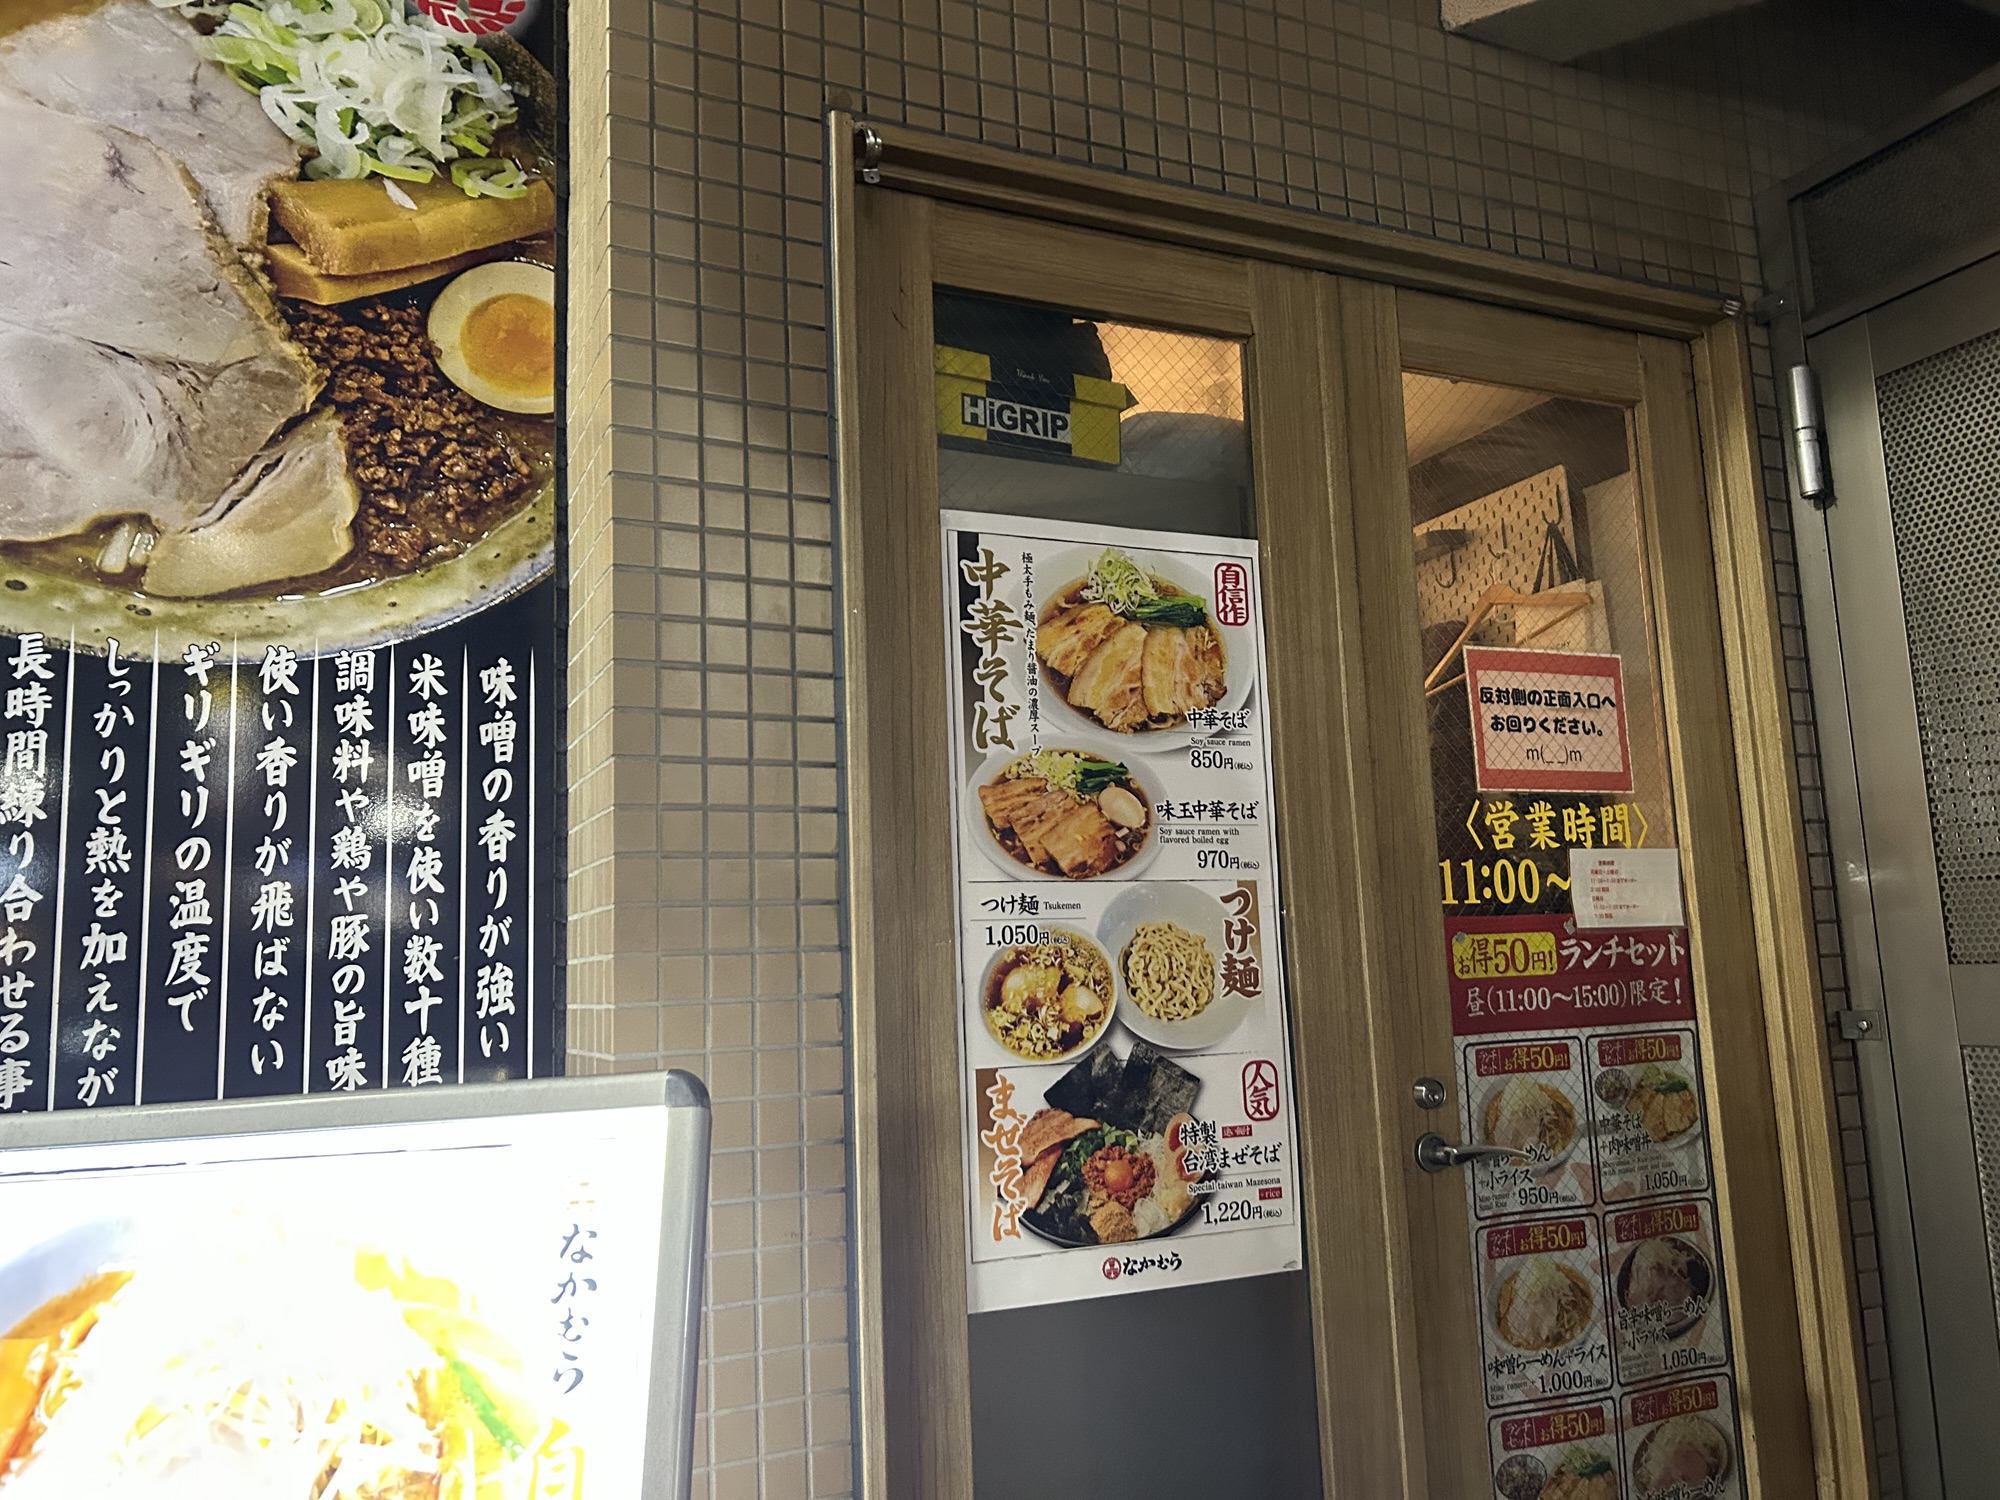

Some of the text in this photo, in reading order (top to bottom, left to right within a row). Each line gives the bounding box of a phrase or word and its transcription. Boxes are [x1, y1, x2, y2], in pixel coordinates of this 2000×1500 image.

[963, 395, 1069, 439] HiGRIP
[1218, 566, 1246, 624] 自信作
[965, 549, 1023, 750] 中華そば
[1187, 709, 1249, 731] 中華そば
[1479, 687, 1616, 710] 反対側の正面入口へ
[1190, 737, 1251, 747] Soy sauce ramen
[1490, 714, 1604, 737] お回りください。
[1156, 800, 1259, 822] 味玉中華そば
[1159, 827, 1240, 838] Soy sauce ramen with
[165, 641, 221, 1032] ギリギリの温度で
[477, 658, 517, 1057] 味噌の香りが強い
[1159, 835, 1230, 846] flavored boiled egg
[0, 632, 55, 1113] 長時間練り合わせる事
[77, 637, 135, 1107] しっかりと熱を加えなが
[250, 645, 299, 1075] 使い香りが飛ばない
[326, 650, 377, 1091] 調味料や鶏や豚の旨味
[401, 653, 448, 1087] 米味噌を使い数十種
[980, 892, 1081, 917] つけ麺 Tsukemen
[1220, 887, 1262, 999] つけ麺
[1458, 933, 1686, 976] お得50円! ランチセット
[1246, 1062, 1275, 1116] 人気
[1180, 1120, 1218, 1146] 特製
[1599, 1112, 1642, 1134] 中華そば
[983, 1073, 1028, 1242] まぜそば
[1183, 1142, 1282, 1173] 台湾まぜそば
[1188, 1182, 1215, 1193] Special
[1218, 1180, 1243, 1190] taiwan
[1123, 1251, 1182, 1276] なかむら
[550, 1223, 598, 1395] なかむら
